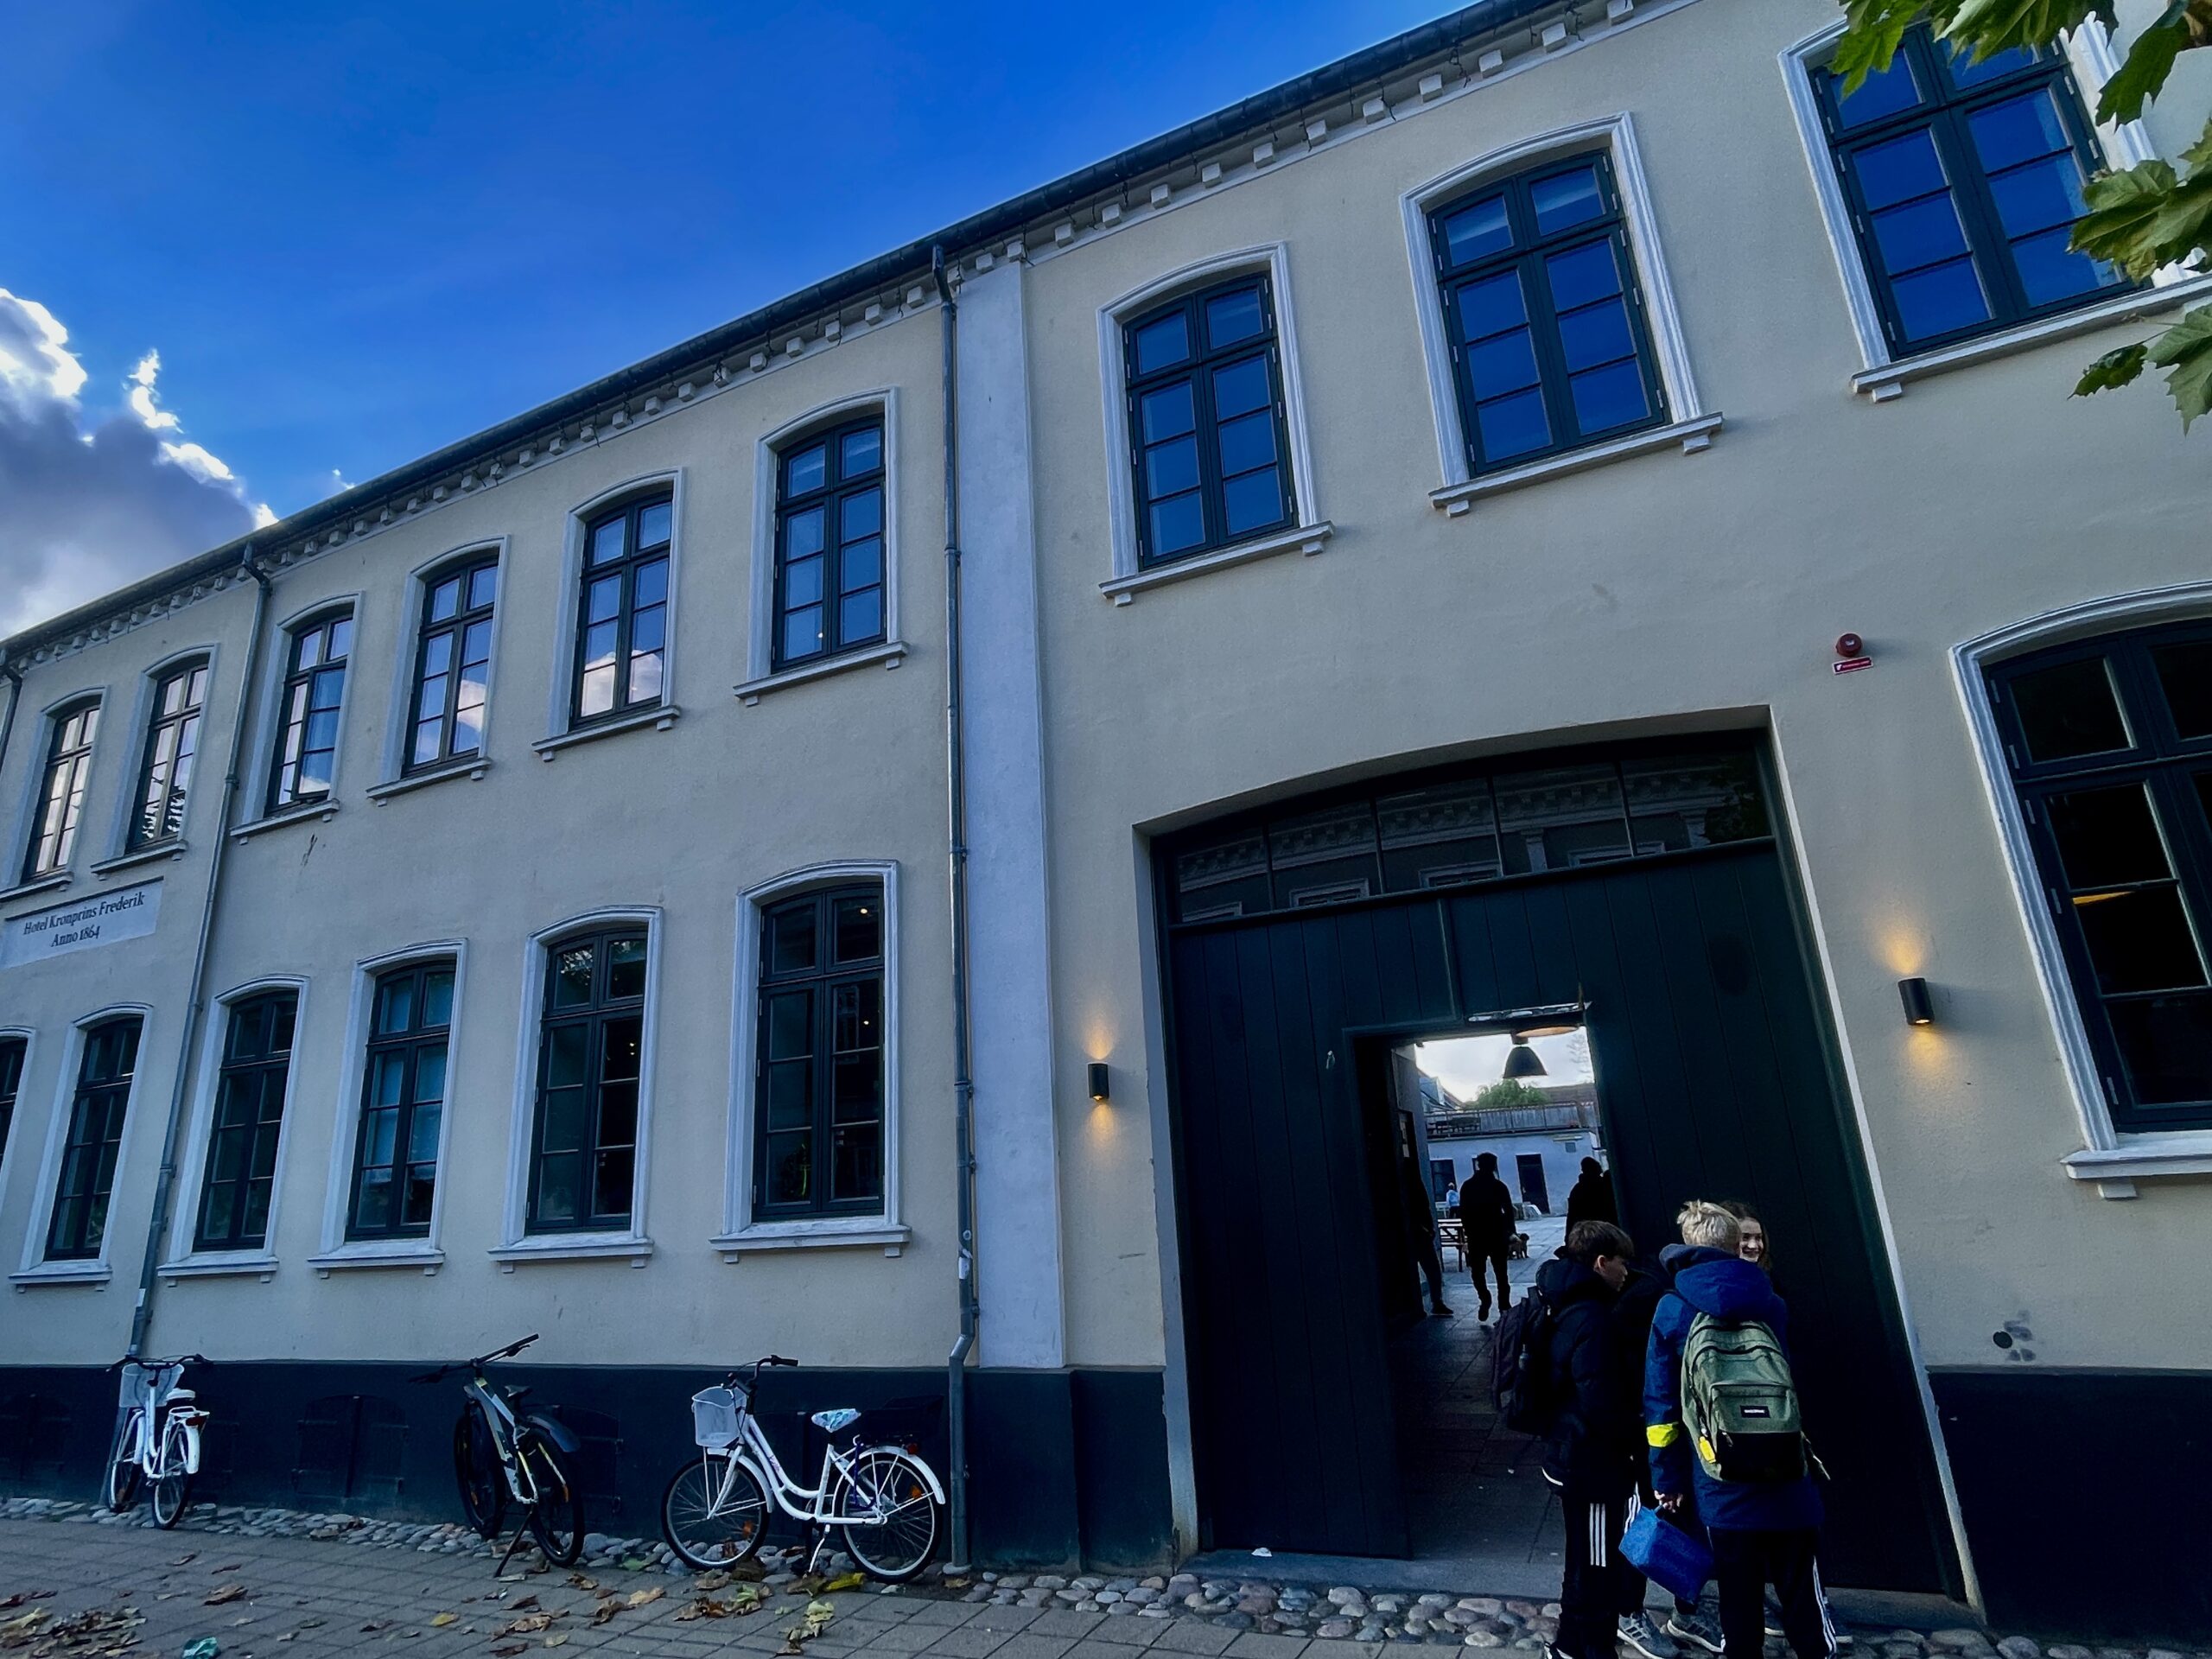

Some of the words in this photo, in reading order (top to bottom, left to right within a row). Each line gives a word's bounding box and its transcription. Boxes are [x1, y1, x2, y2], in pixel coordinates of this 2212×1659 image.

[23, 917, 48, 935] Hotel
[49, 907, 97, 929] Kronprins
[99, 892, 144, 916] Frederik
[51, 931, 79, 947] Anno
[79, 925, 101, 941] 1864
